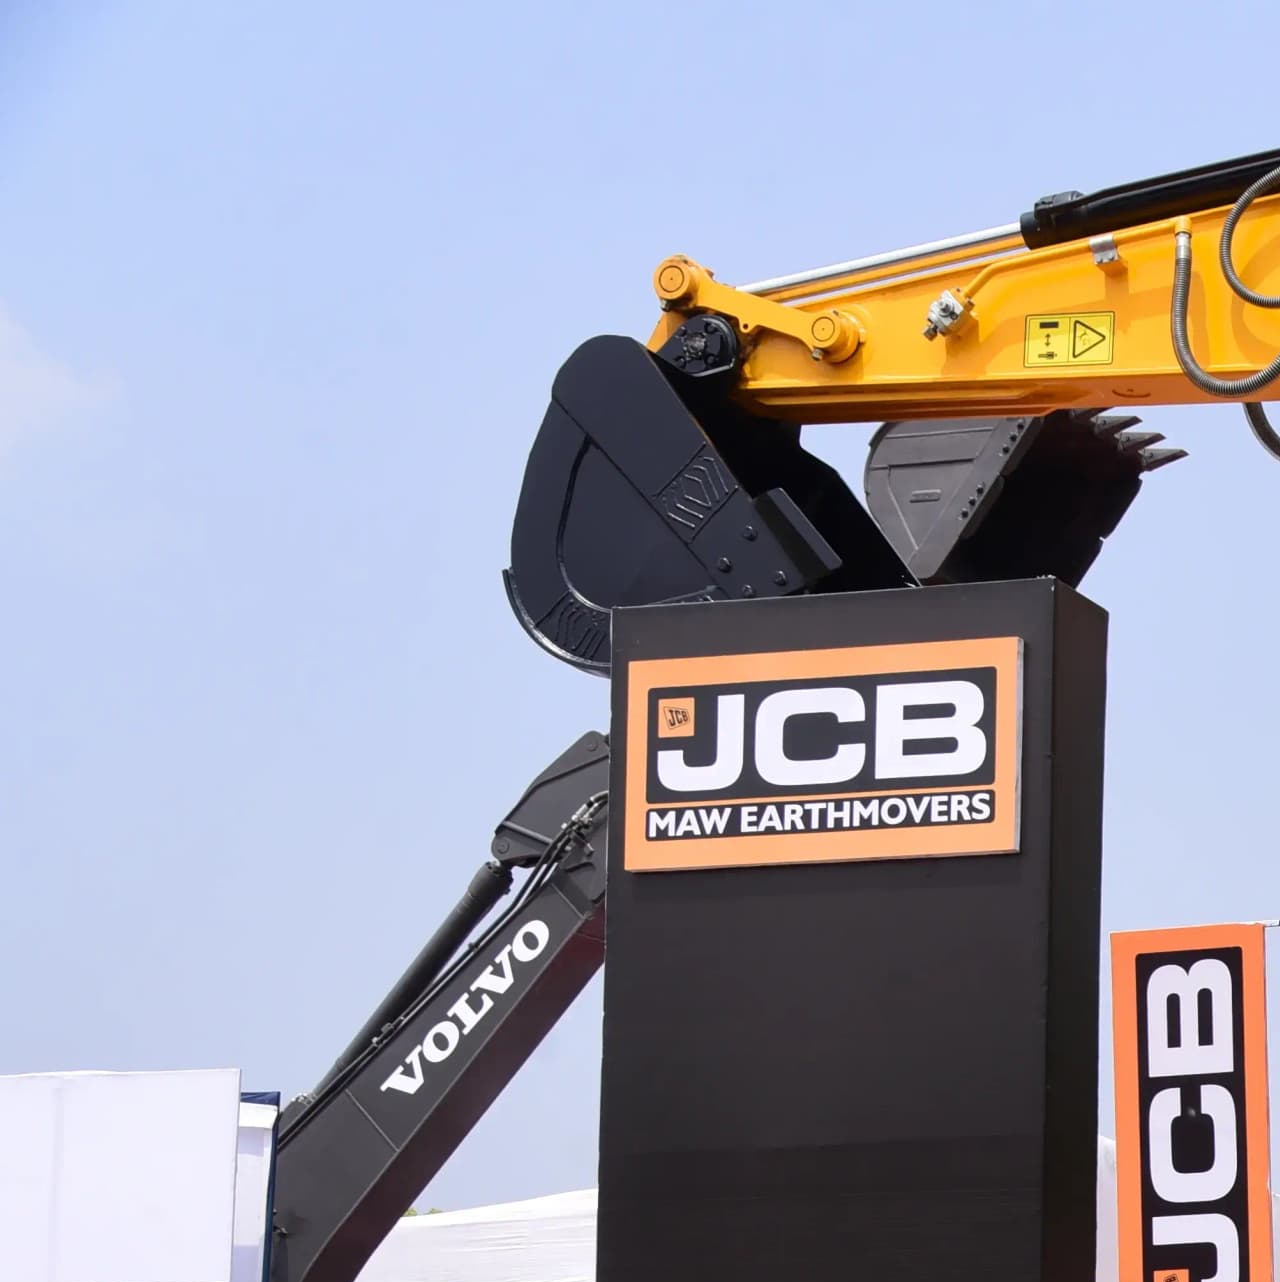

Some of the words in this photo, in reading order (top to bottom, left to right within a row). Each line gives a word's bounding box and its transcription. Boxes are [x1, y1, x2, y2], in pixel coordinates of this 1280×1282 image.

[657, 680, 987, 792] JCB
[667, 708, 689, 728] JCB
[648, 807, 731, 838] MAW
[740, 793, 991, 833] EARTHMOVERS
[380, 920, 549, 1095] VOLVO
